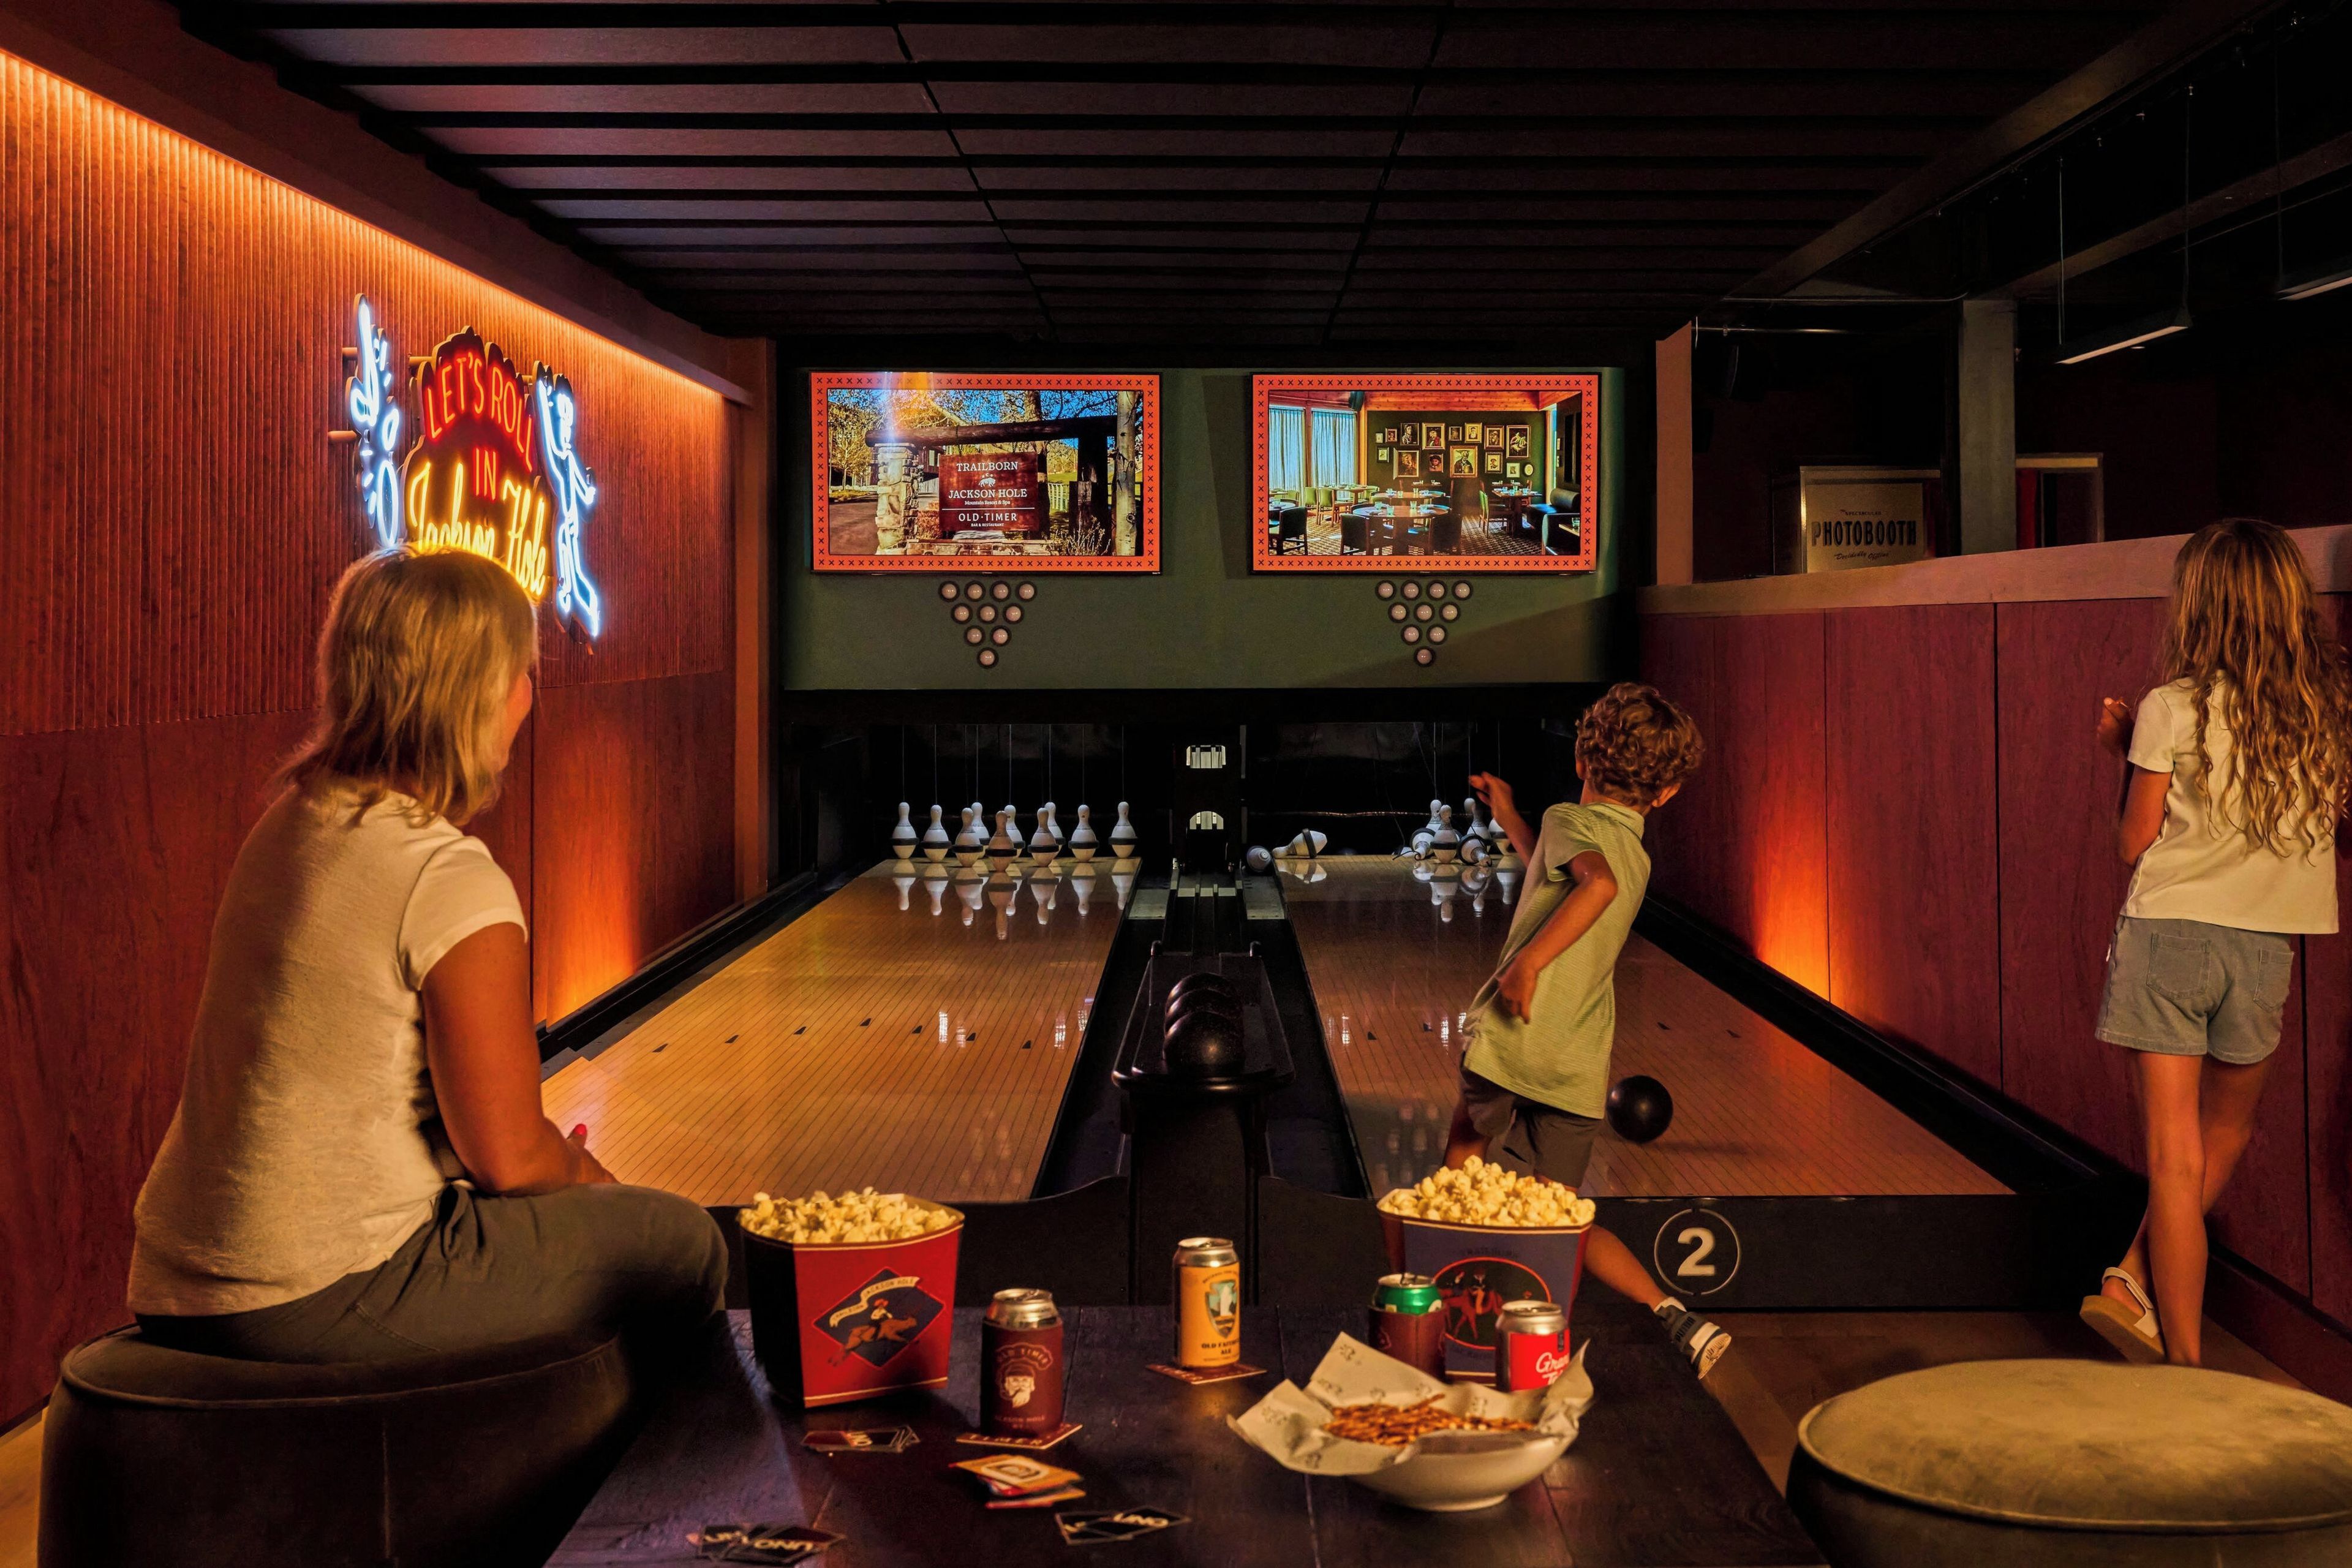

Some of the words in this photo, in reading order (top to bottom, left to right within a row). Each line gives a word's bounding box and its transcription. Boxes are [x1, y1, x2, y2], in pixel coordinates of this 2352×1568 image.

[427, 351, 484, 439] LET'S
[491, 366, 533, 472] ROLL
[474, 447, 496, 501] IN
[956, 461, 1018, 472] TRAILBORN
[948, 489, 995, 499] JACKSON
[998, 488, 1027, 497] HOLE
[502, 478, 546, 596] Hole
[1811, 520, 1917, 547] PHOTOBOOTH
[1677, 1226, 1715, 1276] 2
